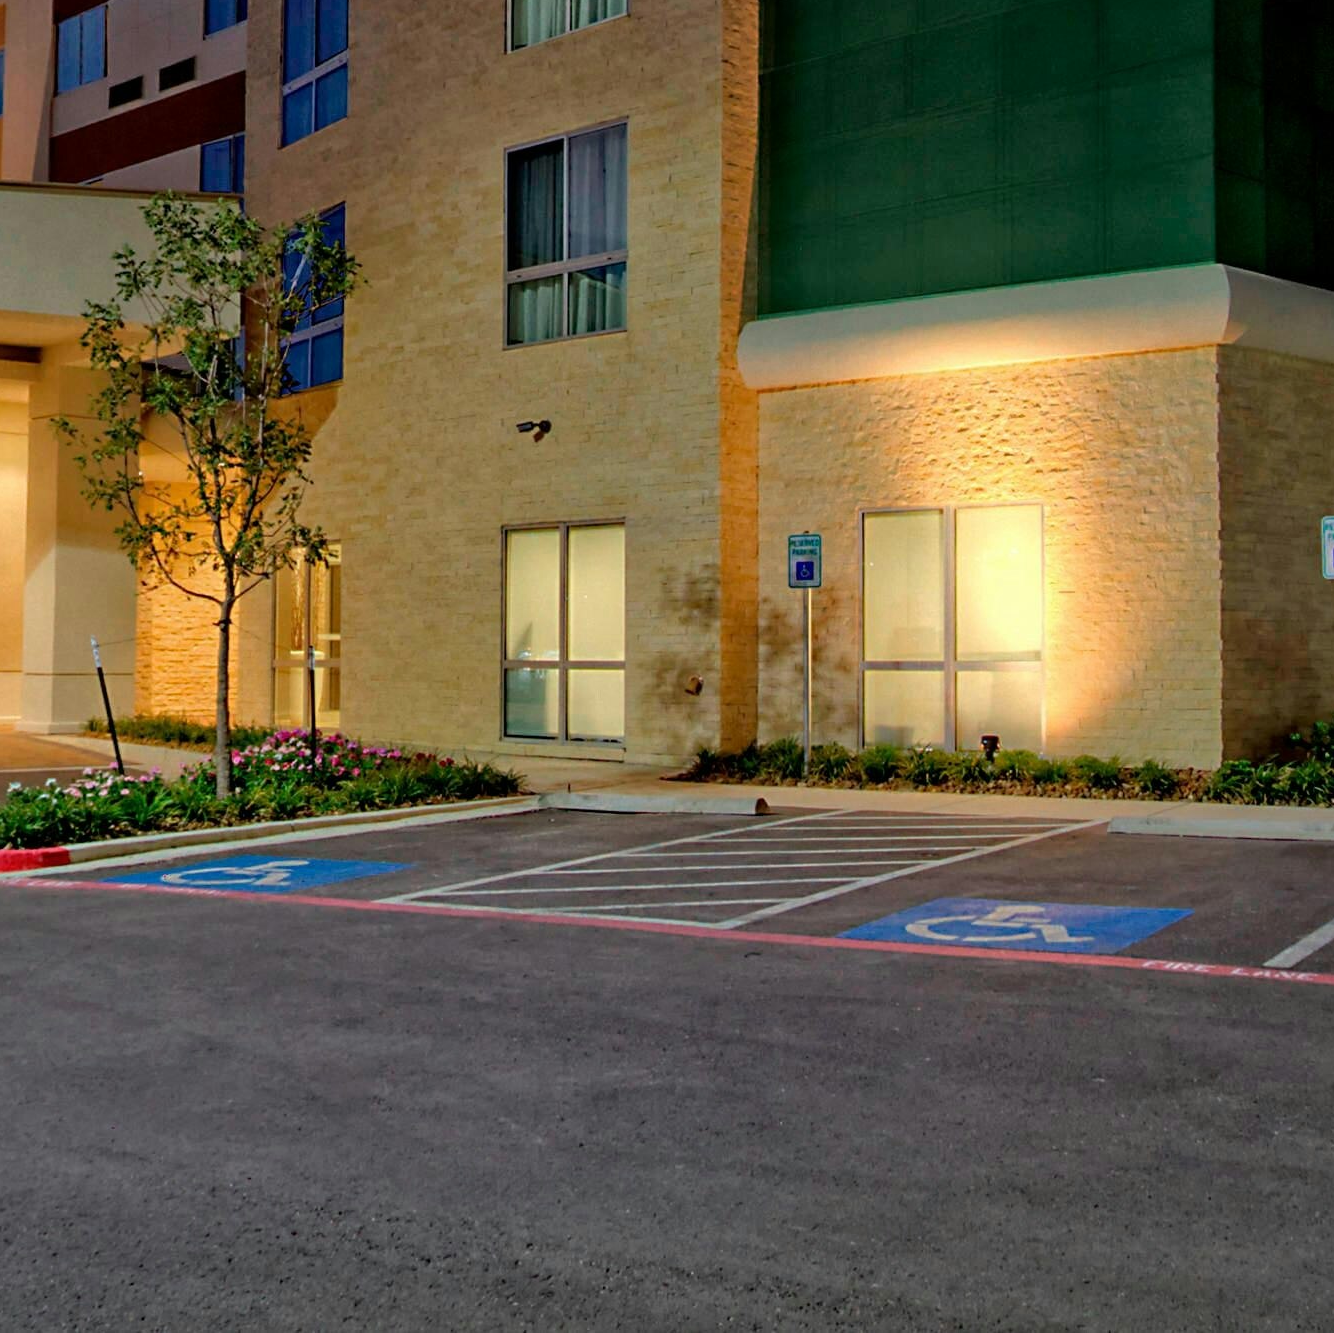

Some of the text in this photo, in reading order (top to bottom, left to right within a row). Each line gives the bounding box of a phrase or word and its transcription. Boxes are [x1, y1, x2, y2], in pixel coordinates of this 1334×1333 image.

[792, 548, 818, 556] PARKING
[1141, 959, 1214, 974] FIRE
[1230, 967, 1318, 982] LANE
